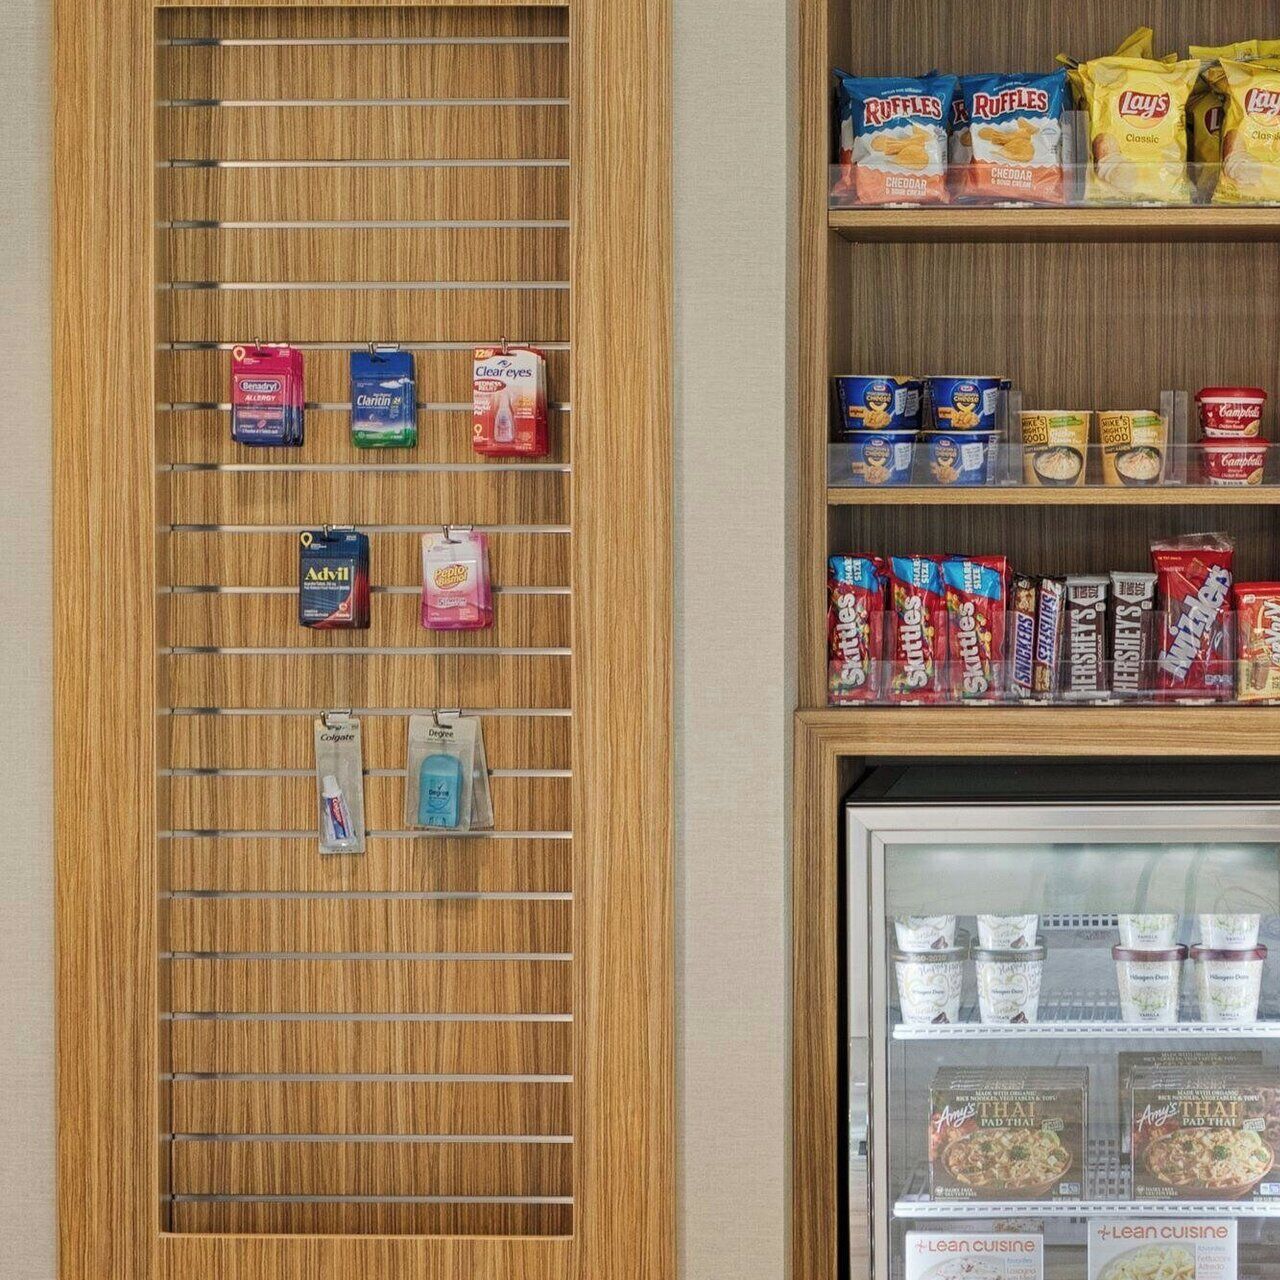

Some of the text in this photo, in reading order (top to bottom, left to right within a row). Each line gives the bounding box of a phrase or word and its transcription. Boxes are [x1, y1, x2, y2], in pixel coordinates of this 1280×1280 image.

[864, 96, 943, 127] RUFFLES
[971, 87, 1049, 120] RUFFLES
[1126, 133, 1160, 144] Classic
[991, 168, 1033, 181] CHEDDAR
[885, 177, 927, 189] CHEDDAR
[475, 366, 532, 379] Clear eyes
[242, 382, 277, 392] Benadryl
[357, 394, 391, 406] Claritin
[1024, 434, 1046, 443] GOOD
[1104, 434, 1129, 443] GOOD
[305, 566, 349, 581] Advil
[973, 563, 982, 589] SIZE
[837, 593, 866, 686] Skittles
[901, 595, 928, 687] Skittles
[959, 601, 988, 694] Skittles
[1015, 613, 1034, 684] SNICKERS
[1071, 608, 1097, 693] HERSHEY'S
[1113, 605, 1141, 692] HERSHEY'S
[320, 733, 355, 743] Colgate
[428, 729, 454, 739] Degree
[934, 1102, 978, 1133] Amy's
[978, 1101, 1036, 1118] THAI
[1136, 1101, 1180, 1132] Amy's
[1180, 1101, 1238, 1118] THAI
[981, 1118, 1034, 1127] PAD THAI
[1182, 1118, 1236, 1127] PAD THAI
